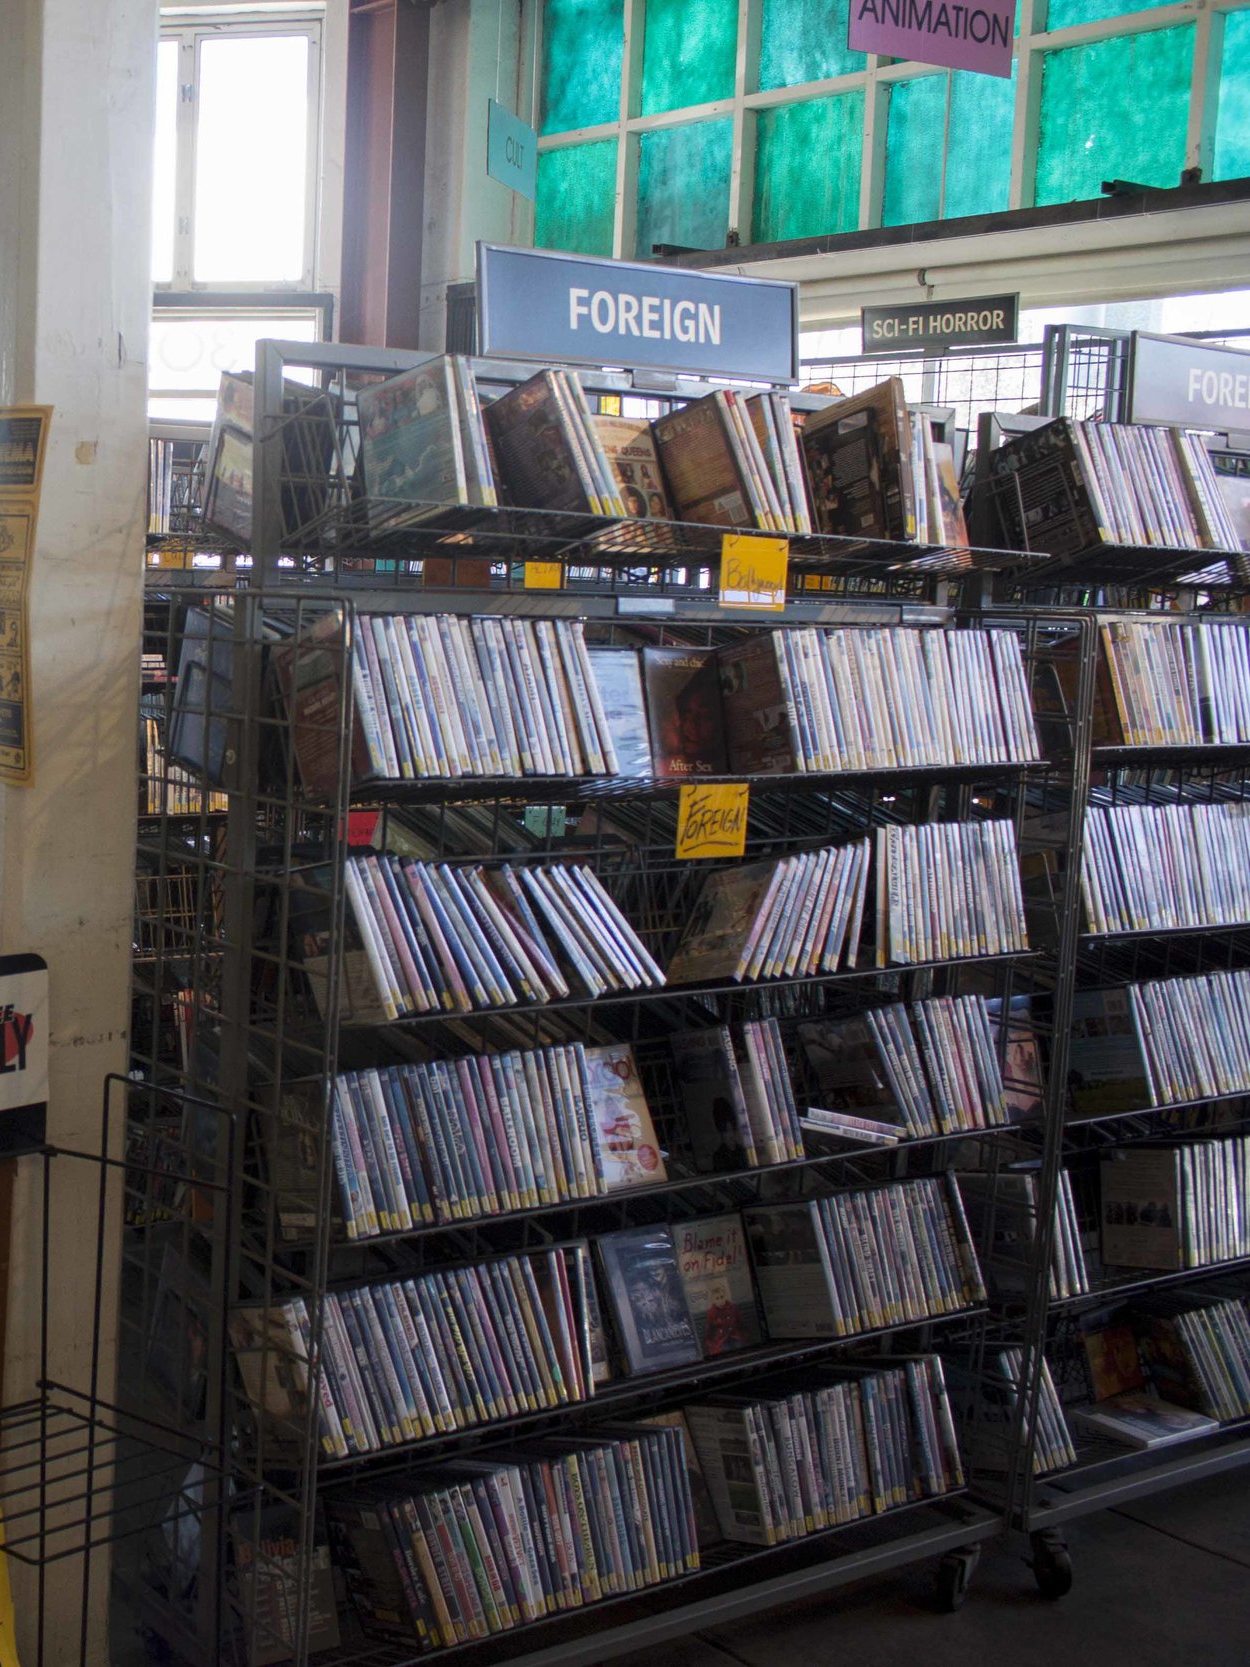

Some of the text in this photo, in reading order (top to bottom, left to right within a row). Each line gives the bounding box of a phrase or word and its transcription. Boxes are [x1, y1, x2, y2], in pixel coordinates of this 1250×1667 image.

[857, 0, 1010, 48] ANIMATION
[505, 135, 525, 170] CULT
[569, 288, 722, 345] FOREIGN
[872, 309, 1005, 338] SCI-FI HORROR
[674, 657, 688, 667] and
[670, 759, 713, 772] After Sex
[680, 794, 743, 845] FOREIGN
[500, 1097, 522, 1168] BALLROOM
[683, 1229, 737, 1254] Blame it
[684, 1244, 742, 1275] on Fidel!
[519, 1506, 530, 1532] Bottle
[404, 1550, 421, 1584] Border
